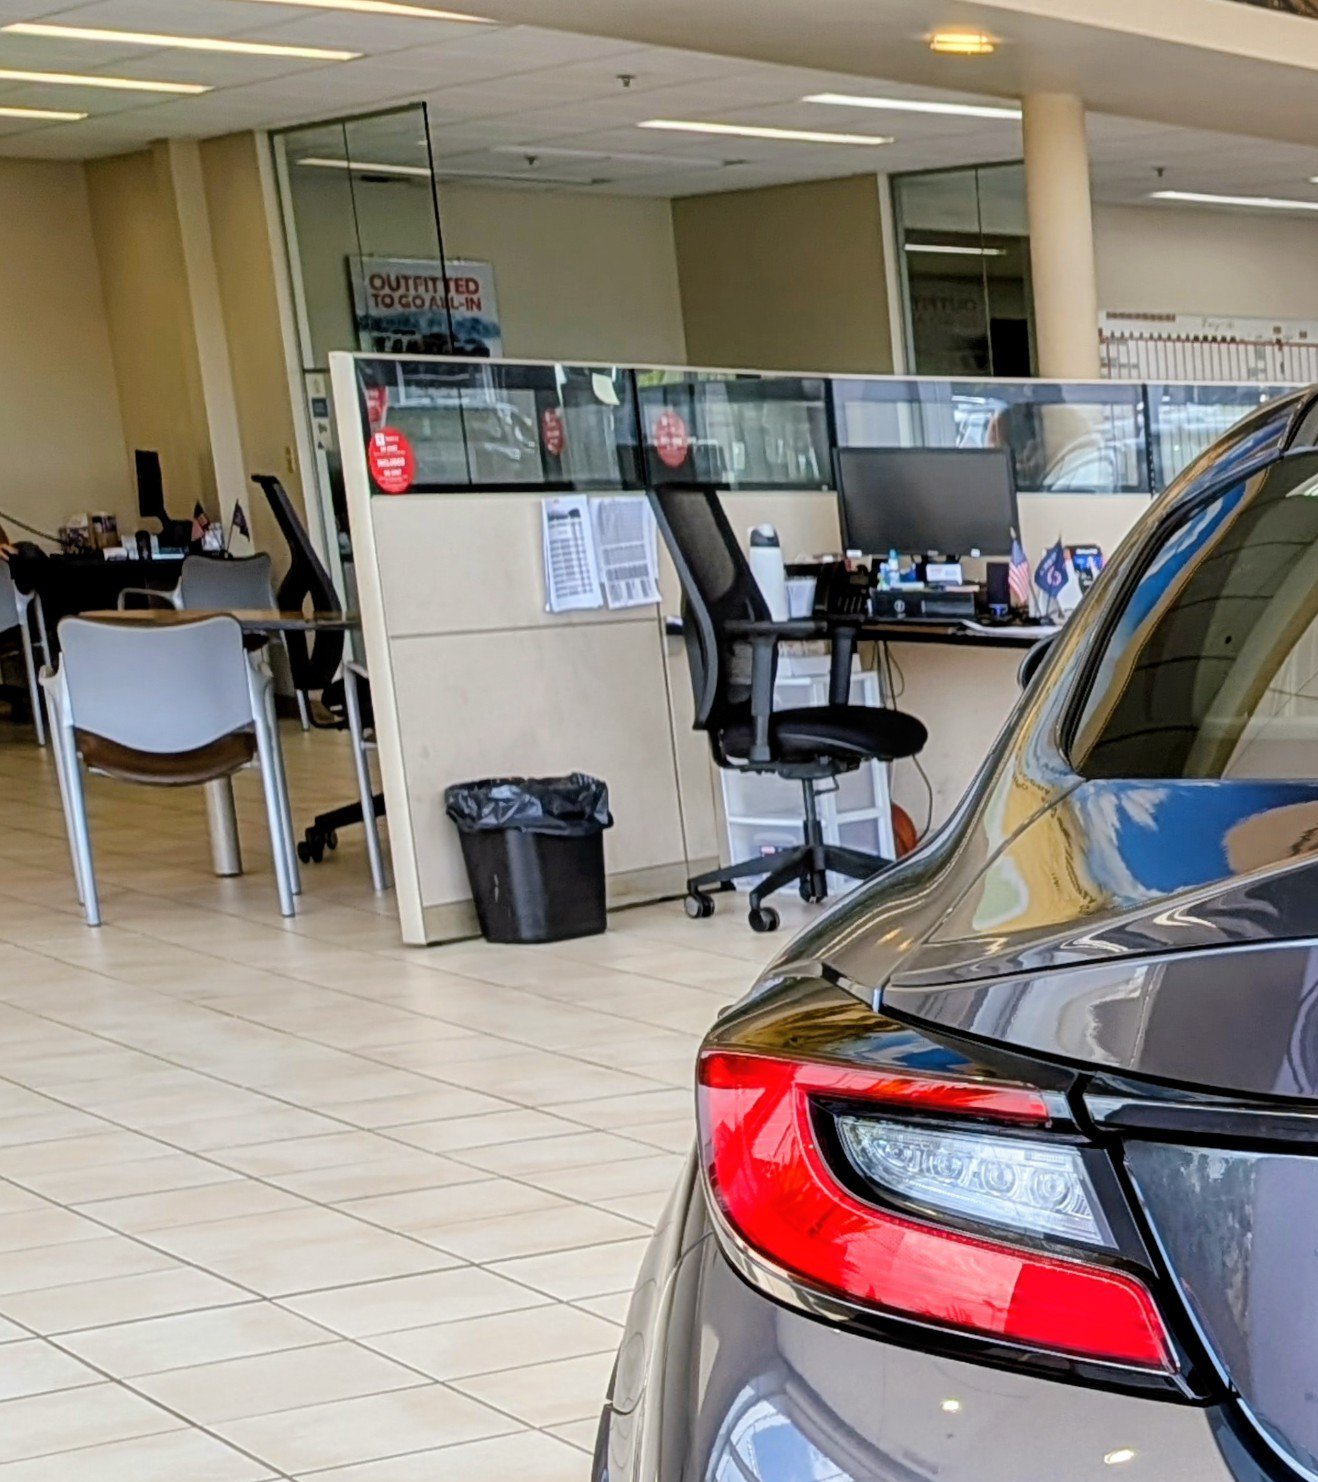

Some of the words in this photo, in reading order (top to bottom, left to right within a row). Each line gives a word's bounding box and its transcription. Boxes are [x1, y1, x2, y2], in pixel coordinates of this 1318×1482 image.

[369, 273, 480, 295] OUTFITTED
[371, 293, 395, 309] TO
[399, 295, 425, 309] GO
[430, 295, 482, 312] ALL-IN
